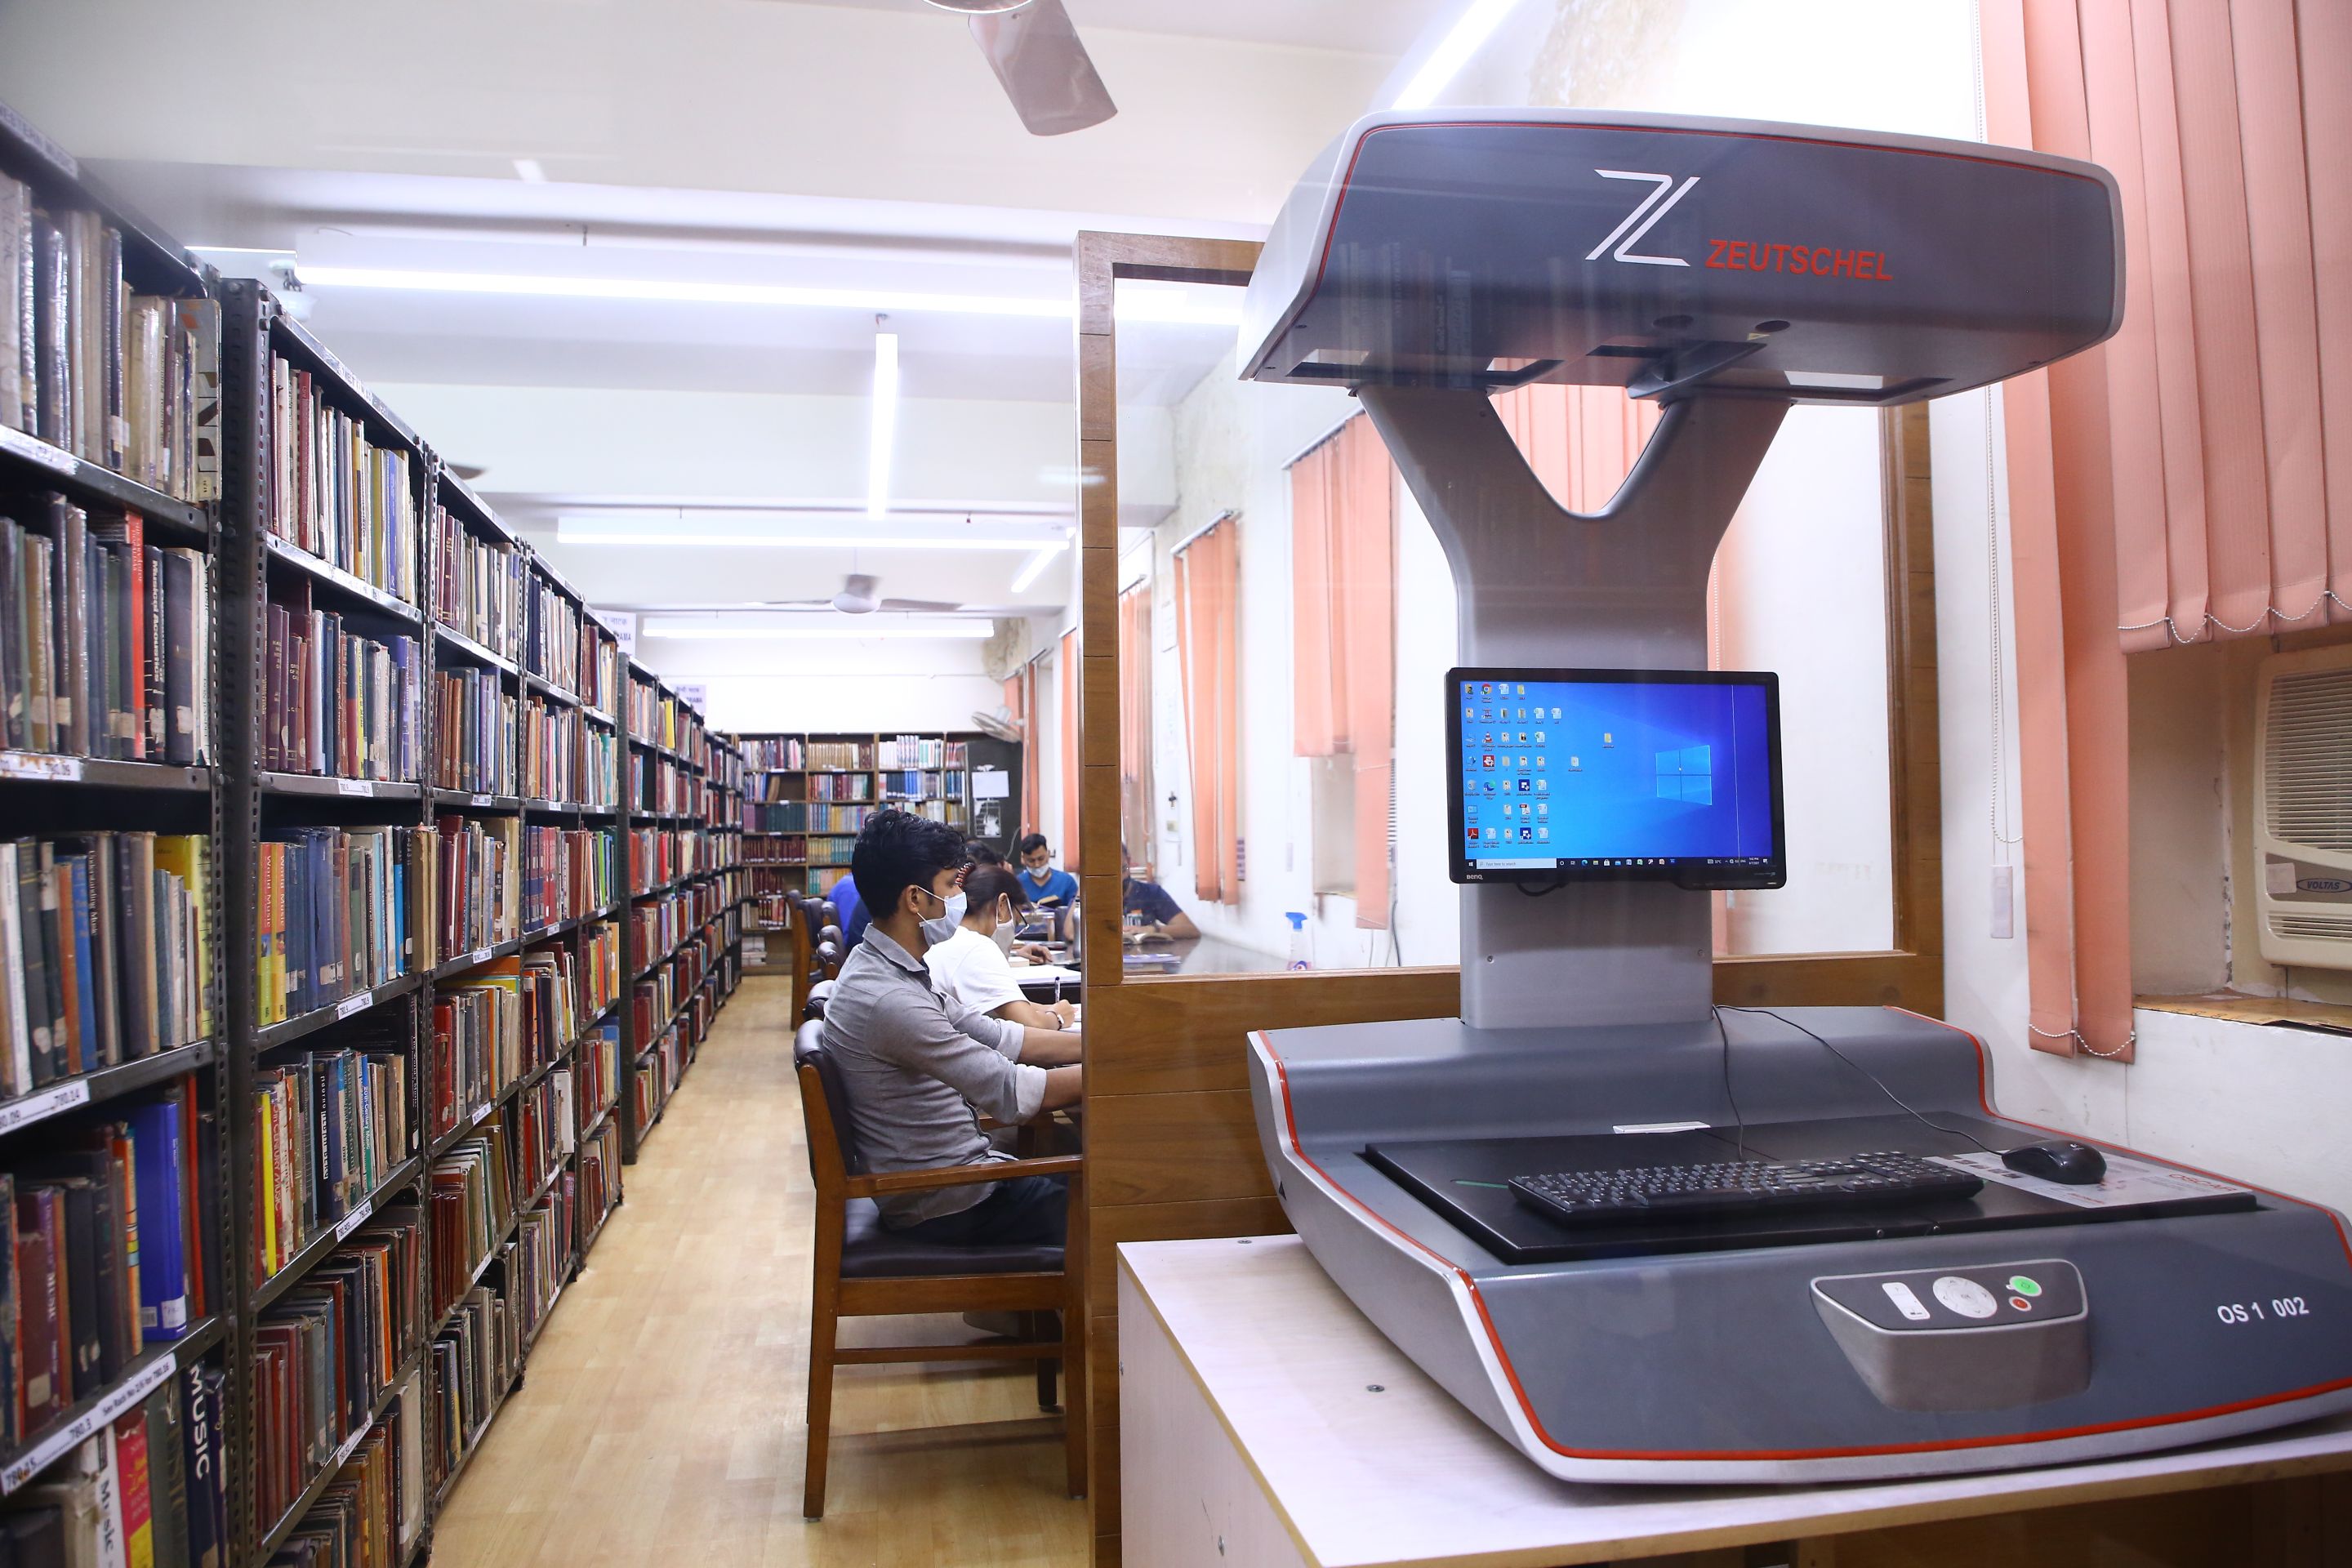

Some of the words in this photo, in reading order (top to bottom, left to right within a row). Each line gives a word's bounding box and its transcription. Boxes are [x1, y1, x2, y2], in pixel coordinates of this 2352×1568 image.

[1704, 239, 1893, 281] ZEUTSCHEL
[88, 850, 96, 909] Understanding
[2307, 881, 2341, 890] VOLTAS
[47, 1272, 56, 1322] MUSIC
[2217, 1304, 2249, 1324] OS
[2252, 1302, 2265, 1320] 1
[2272, 1296, 2310, 1317] 002
[69, 1418, 92, 1439] 780.3
[189, 1364, 209, 1480] MUSIC
